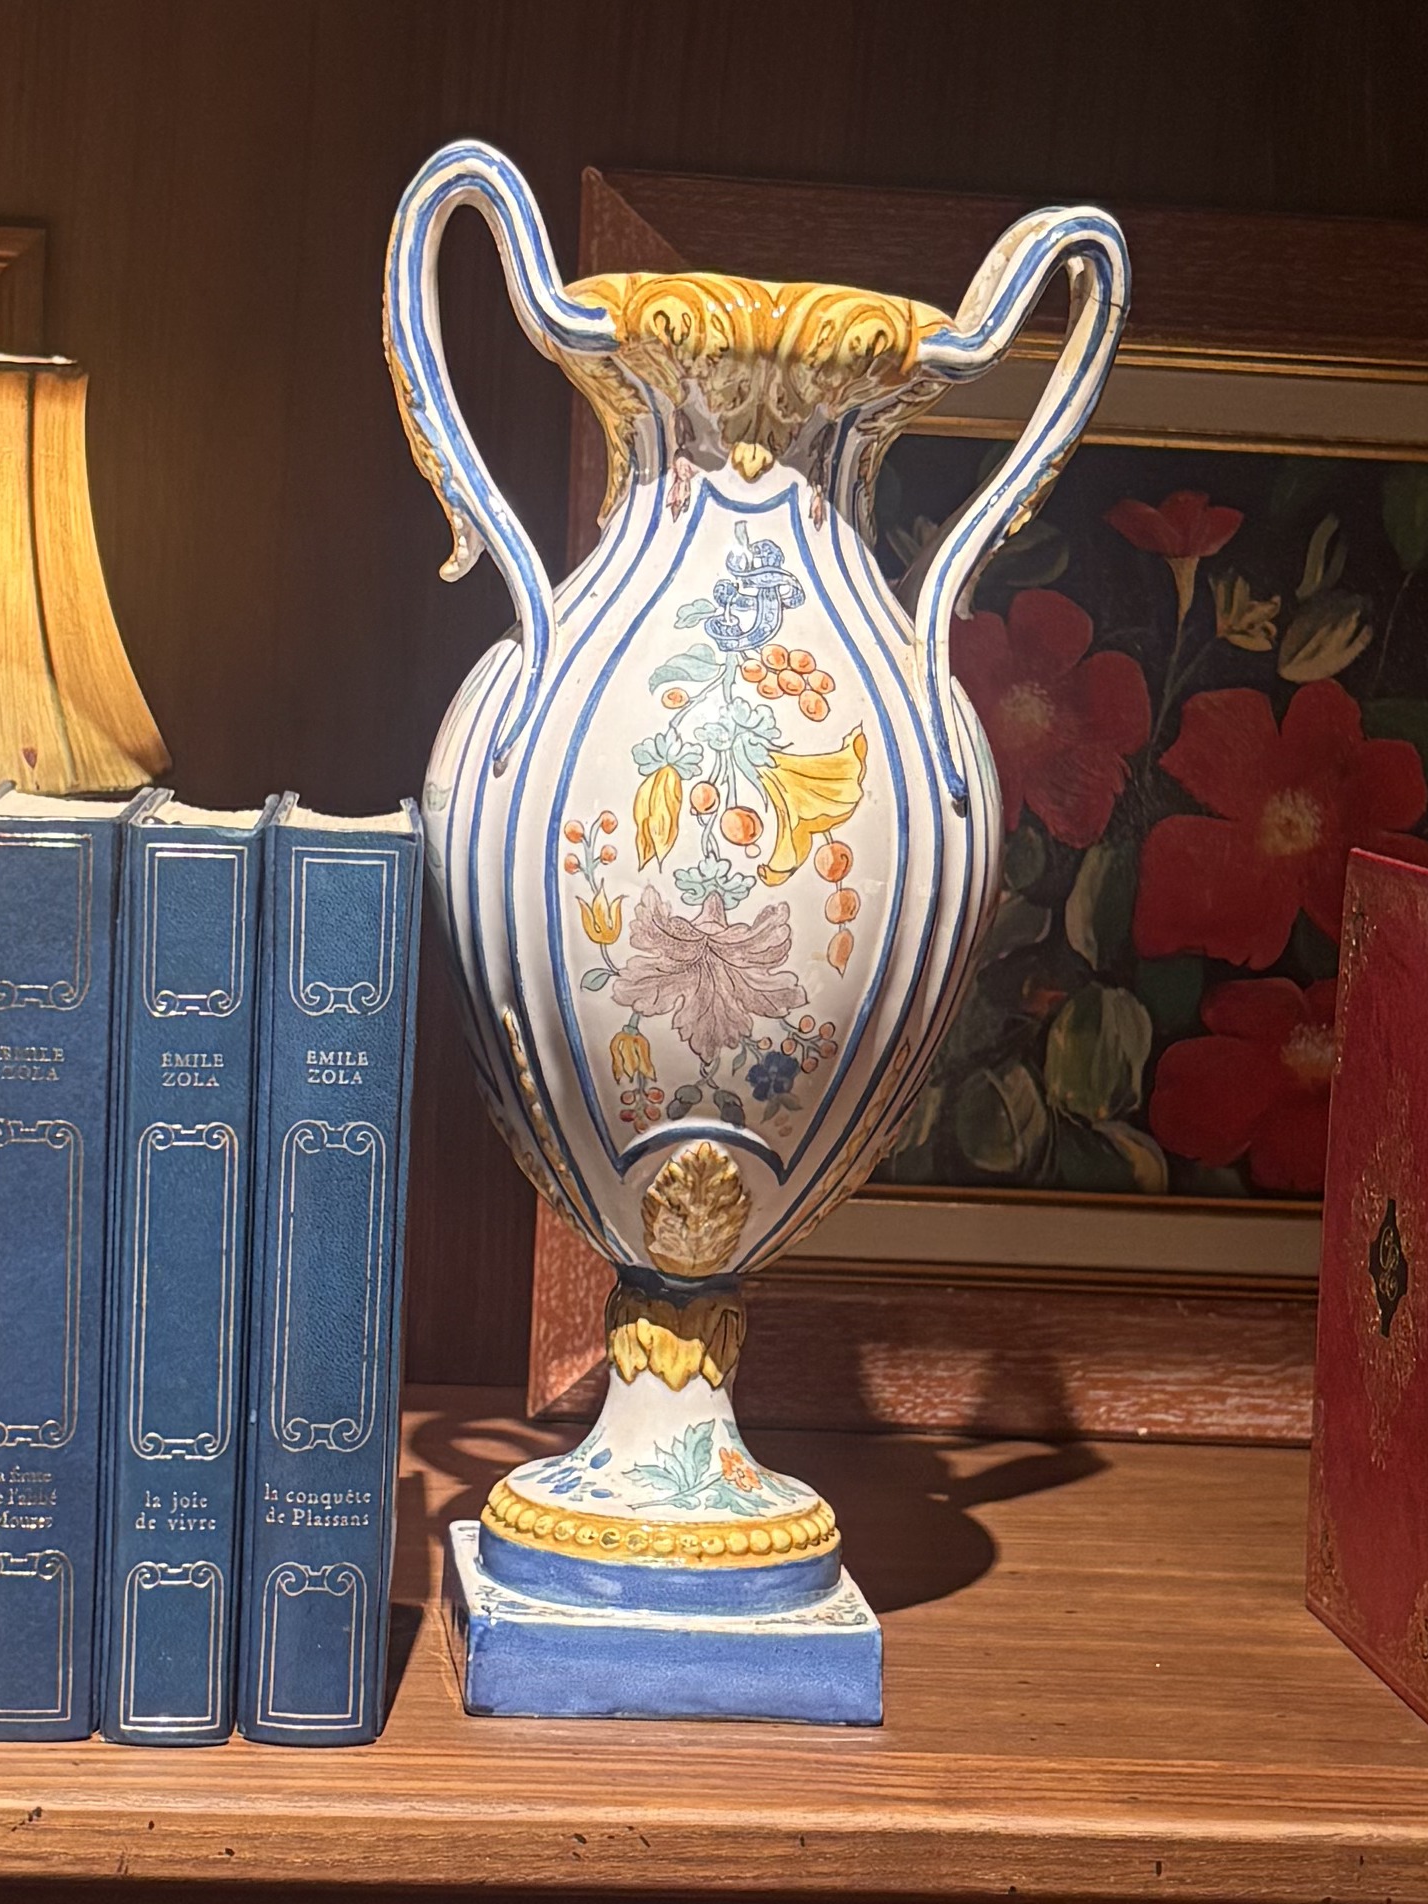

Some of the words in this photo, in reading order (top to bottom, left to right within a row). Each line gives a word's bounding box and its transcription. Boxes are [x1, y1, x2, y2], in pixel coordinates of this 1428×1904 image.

[0, 1065, 61, 1082] ZOLA
[161, 1070, 220, 1088] ZOLA
[306, 1067, 364, 1085] ZOLA
[143, 1489, 162, 1509] la
[170, 1490, 208, 1515] joie
[263, 1482, 279, 1501] la
[285, 1489, 372, 1511] conquête
[134, 1511, 157, 1530] de
[166, 1512, 217, 1531] vivre
[264, 1505, 286, 1524] de
[291, 1507, 370, 1528] Plassans
